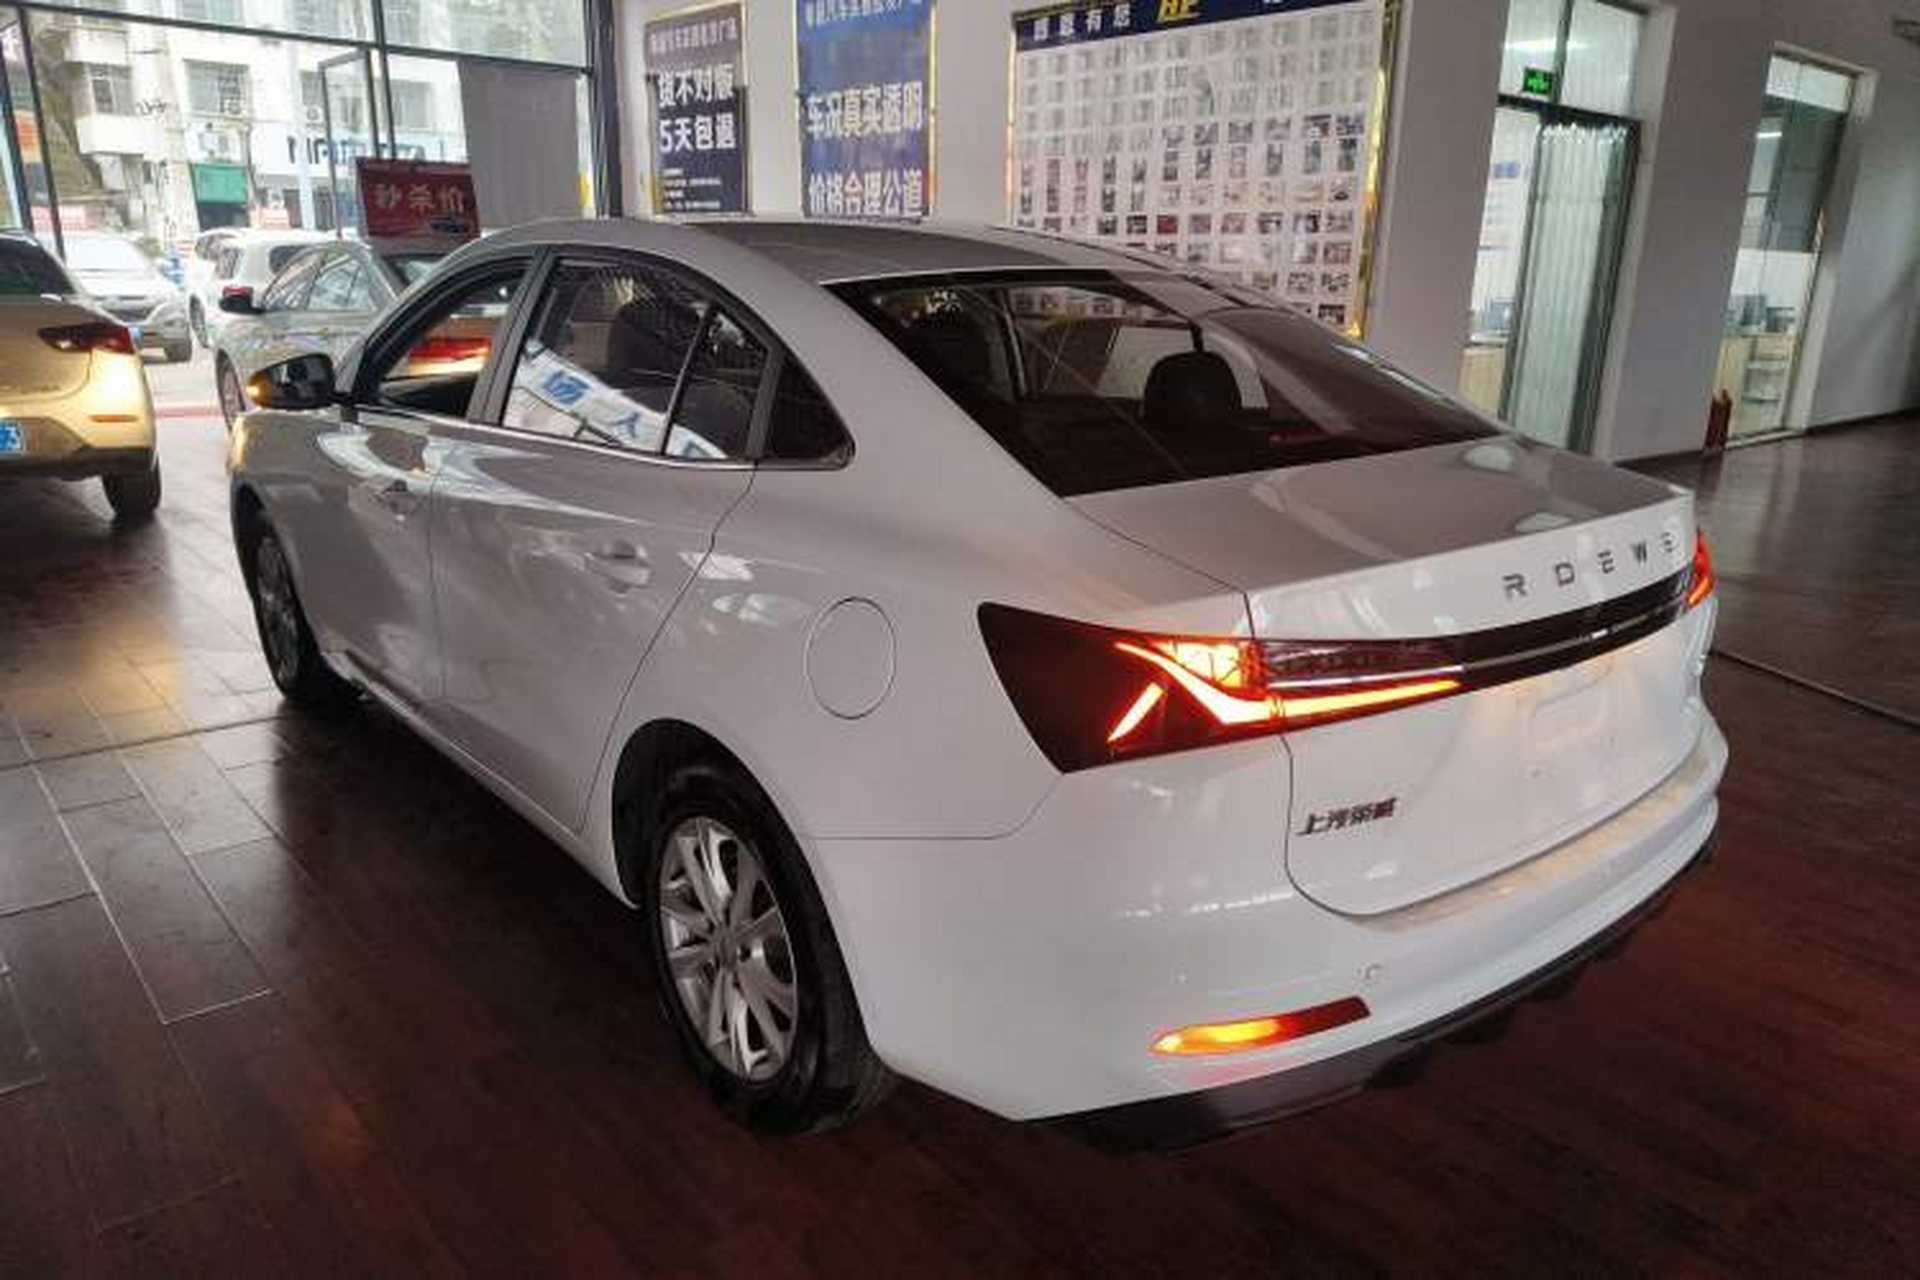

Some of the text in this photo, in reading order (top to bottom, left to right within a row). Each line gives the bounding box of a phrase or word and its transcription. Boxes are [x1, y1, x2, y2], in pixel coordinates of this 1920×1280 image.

[807, 81, 922, 140] 车况真实透明
[659, 113, 736, 153] 5天包退
[375, 182, 464, 214] 秒杀价
[808, 167, 922, 215] 价格合理公道
